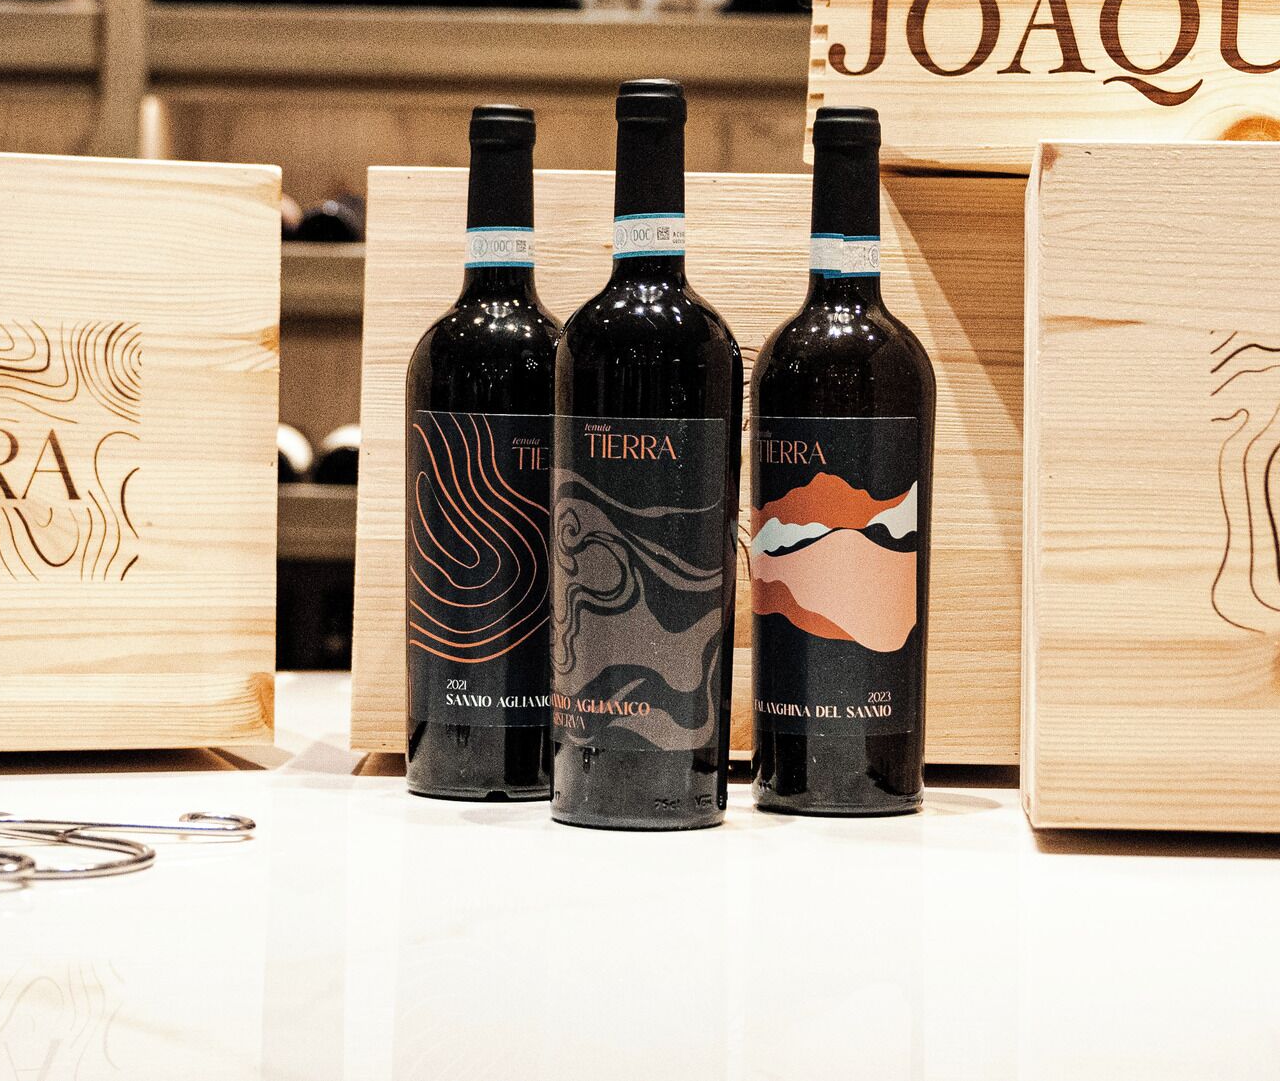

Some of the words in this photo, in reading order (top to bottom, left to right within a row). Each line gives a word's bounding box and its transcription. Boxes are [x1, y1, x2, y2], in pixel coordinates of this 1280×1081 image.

[633, 228, 651, 242] DOC
[584, 423, 611, 432] tenuta
[512, 436, 541, 446] tenuta
[584, 433, 677, 460] TIERRA
[511, 446, 549, 471] TIE
[758, 439, 827, 465] TIERRA
[446, 678, 467, 691] 2021
[446, 693, 492, 708] SANNIO
[496, 695, 551, 709] AGLIANIC
[867, 691, 892, 703] 2023
[575, 698, 651, 717] AGLIANICO
[816, 705, 842, 719] DEL
[846, 704, 892, 719] SANNIO
